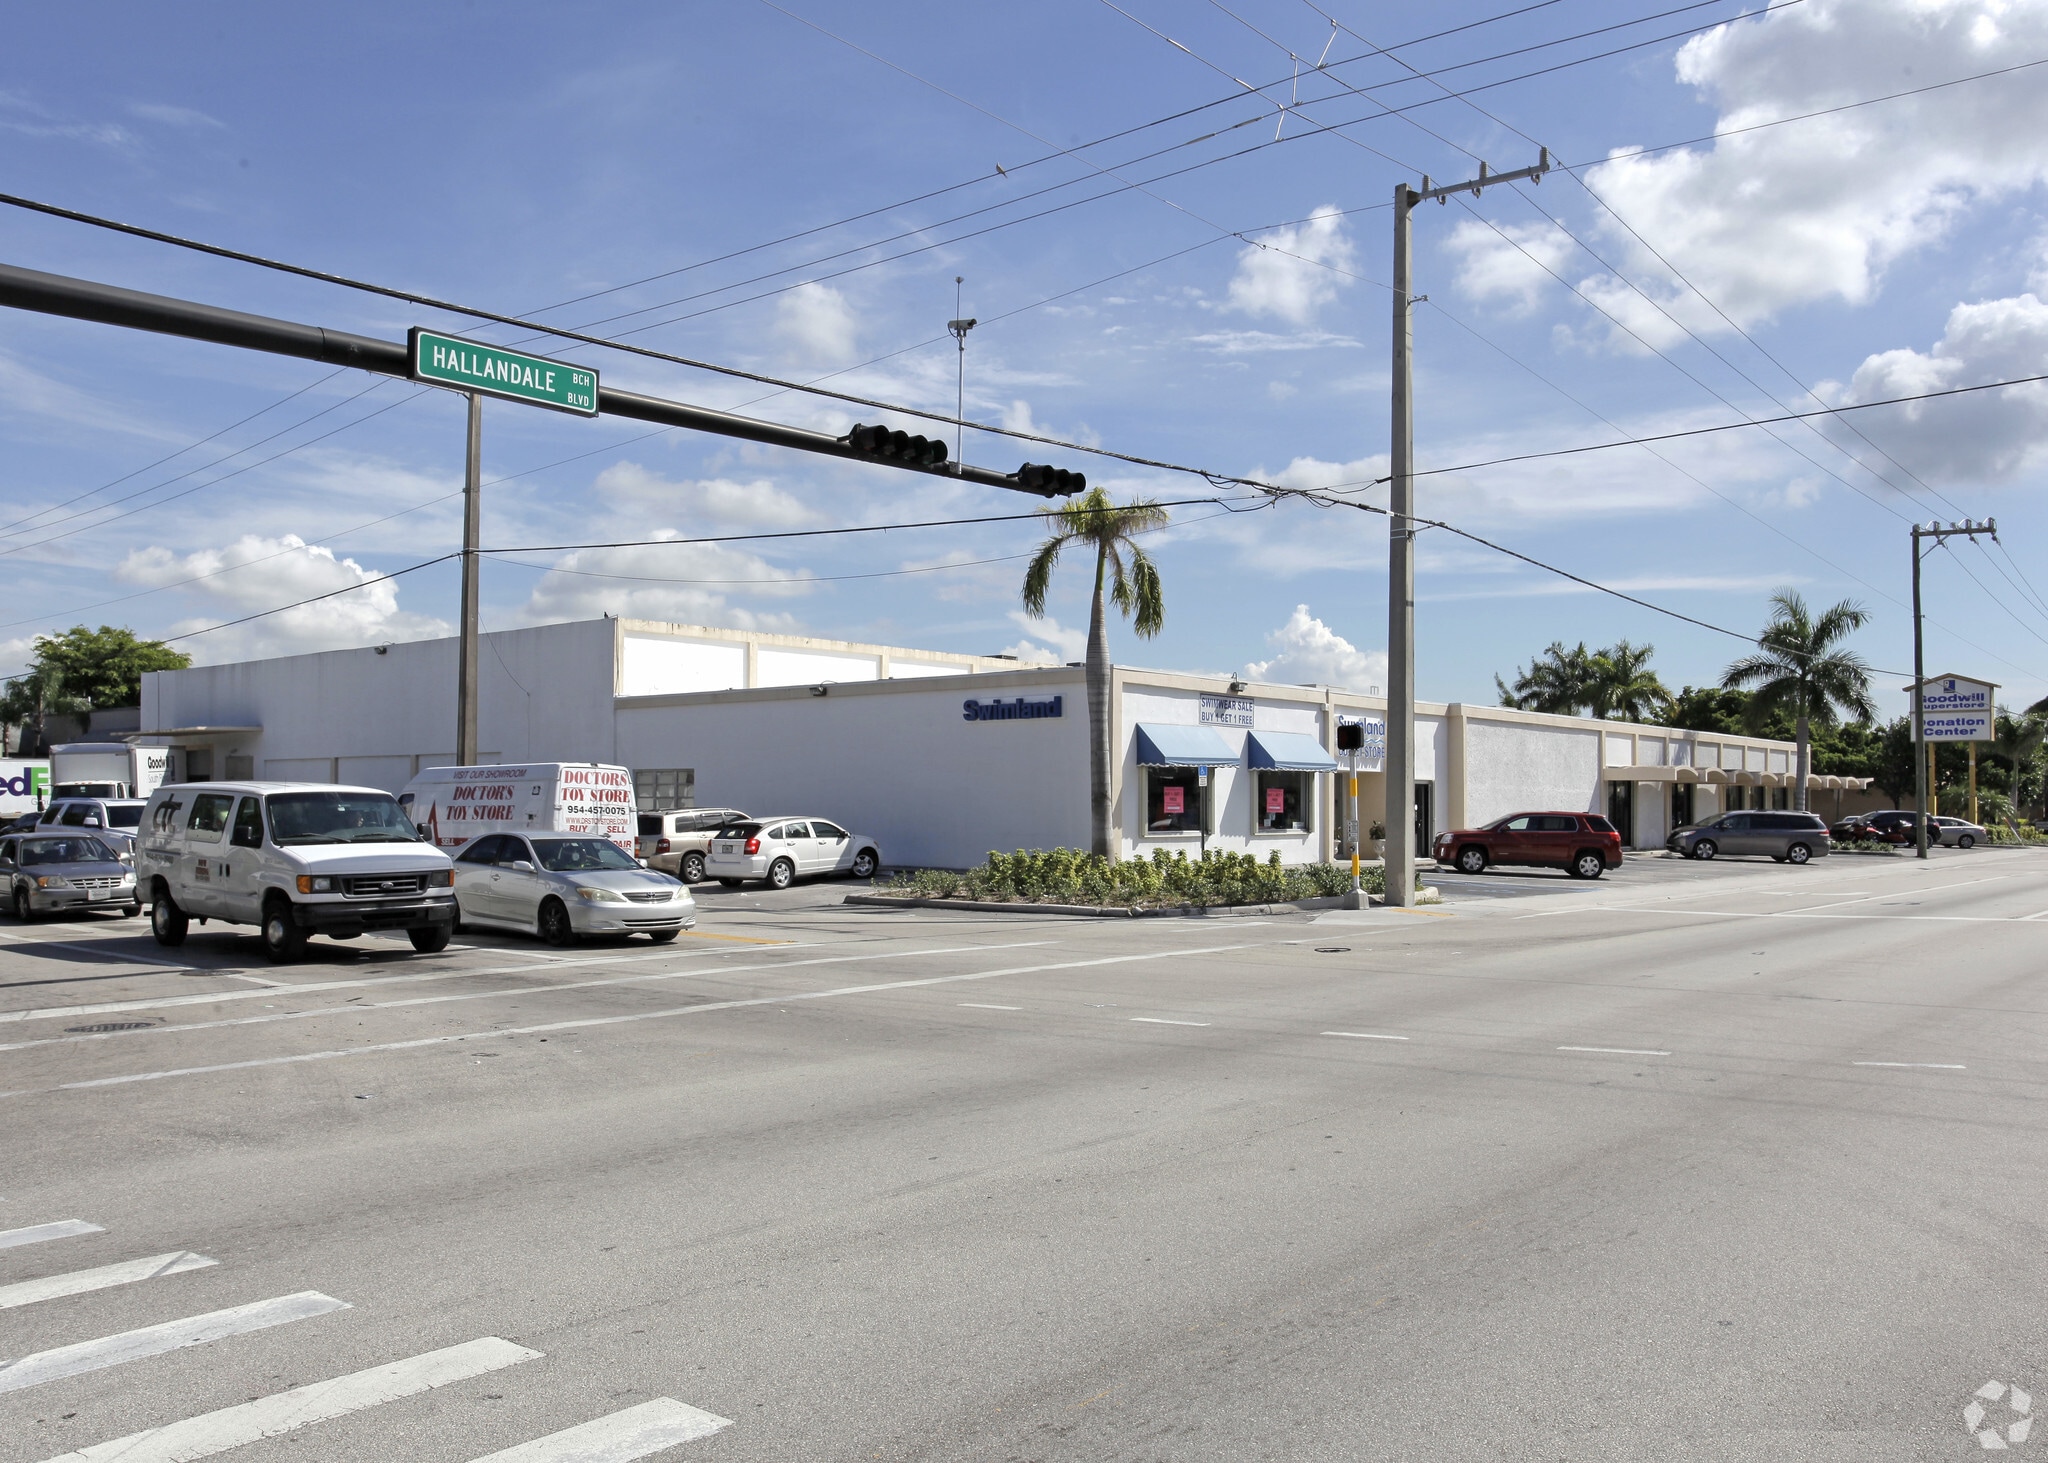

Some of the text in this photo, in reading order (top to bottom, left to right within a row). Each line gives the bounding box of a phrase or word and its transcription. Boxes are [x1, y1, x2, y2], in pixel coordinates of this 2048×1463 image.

[433, 345, 556, 393] HALLANDALE
[572, 372, 590, 387] BCH
[567, 392, 589, 407] BLVD
[963, 696, 1062, 721] Swimland
[1201, 697, 1253, 712] SWIMWEAR SALE
[1924, 702, 1985, 710] uperstore
[1201, 711, 1253, 725] BUY 1 GET 1 FREE
[1924, 718, 1985, 727] onation
[1924, 727, 1977, 736] Center
[454, 768, 527, 780] VISIT OUR SHOWROOM
[564, 770, 628, 786] DOCTORS
[453, 784, 515, 801] DOCTOR'S
[561, 787, 631, 803] TOY STORE
[446, 804, 516, 820] TOY STORE
[567, 805, 626, 816] 954-457-0075
[569, 825, 627, 834] BUY SELL
[441, 837, 455, 846] SELL
